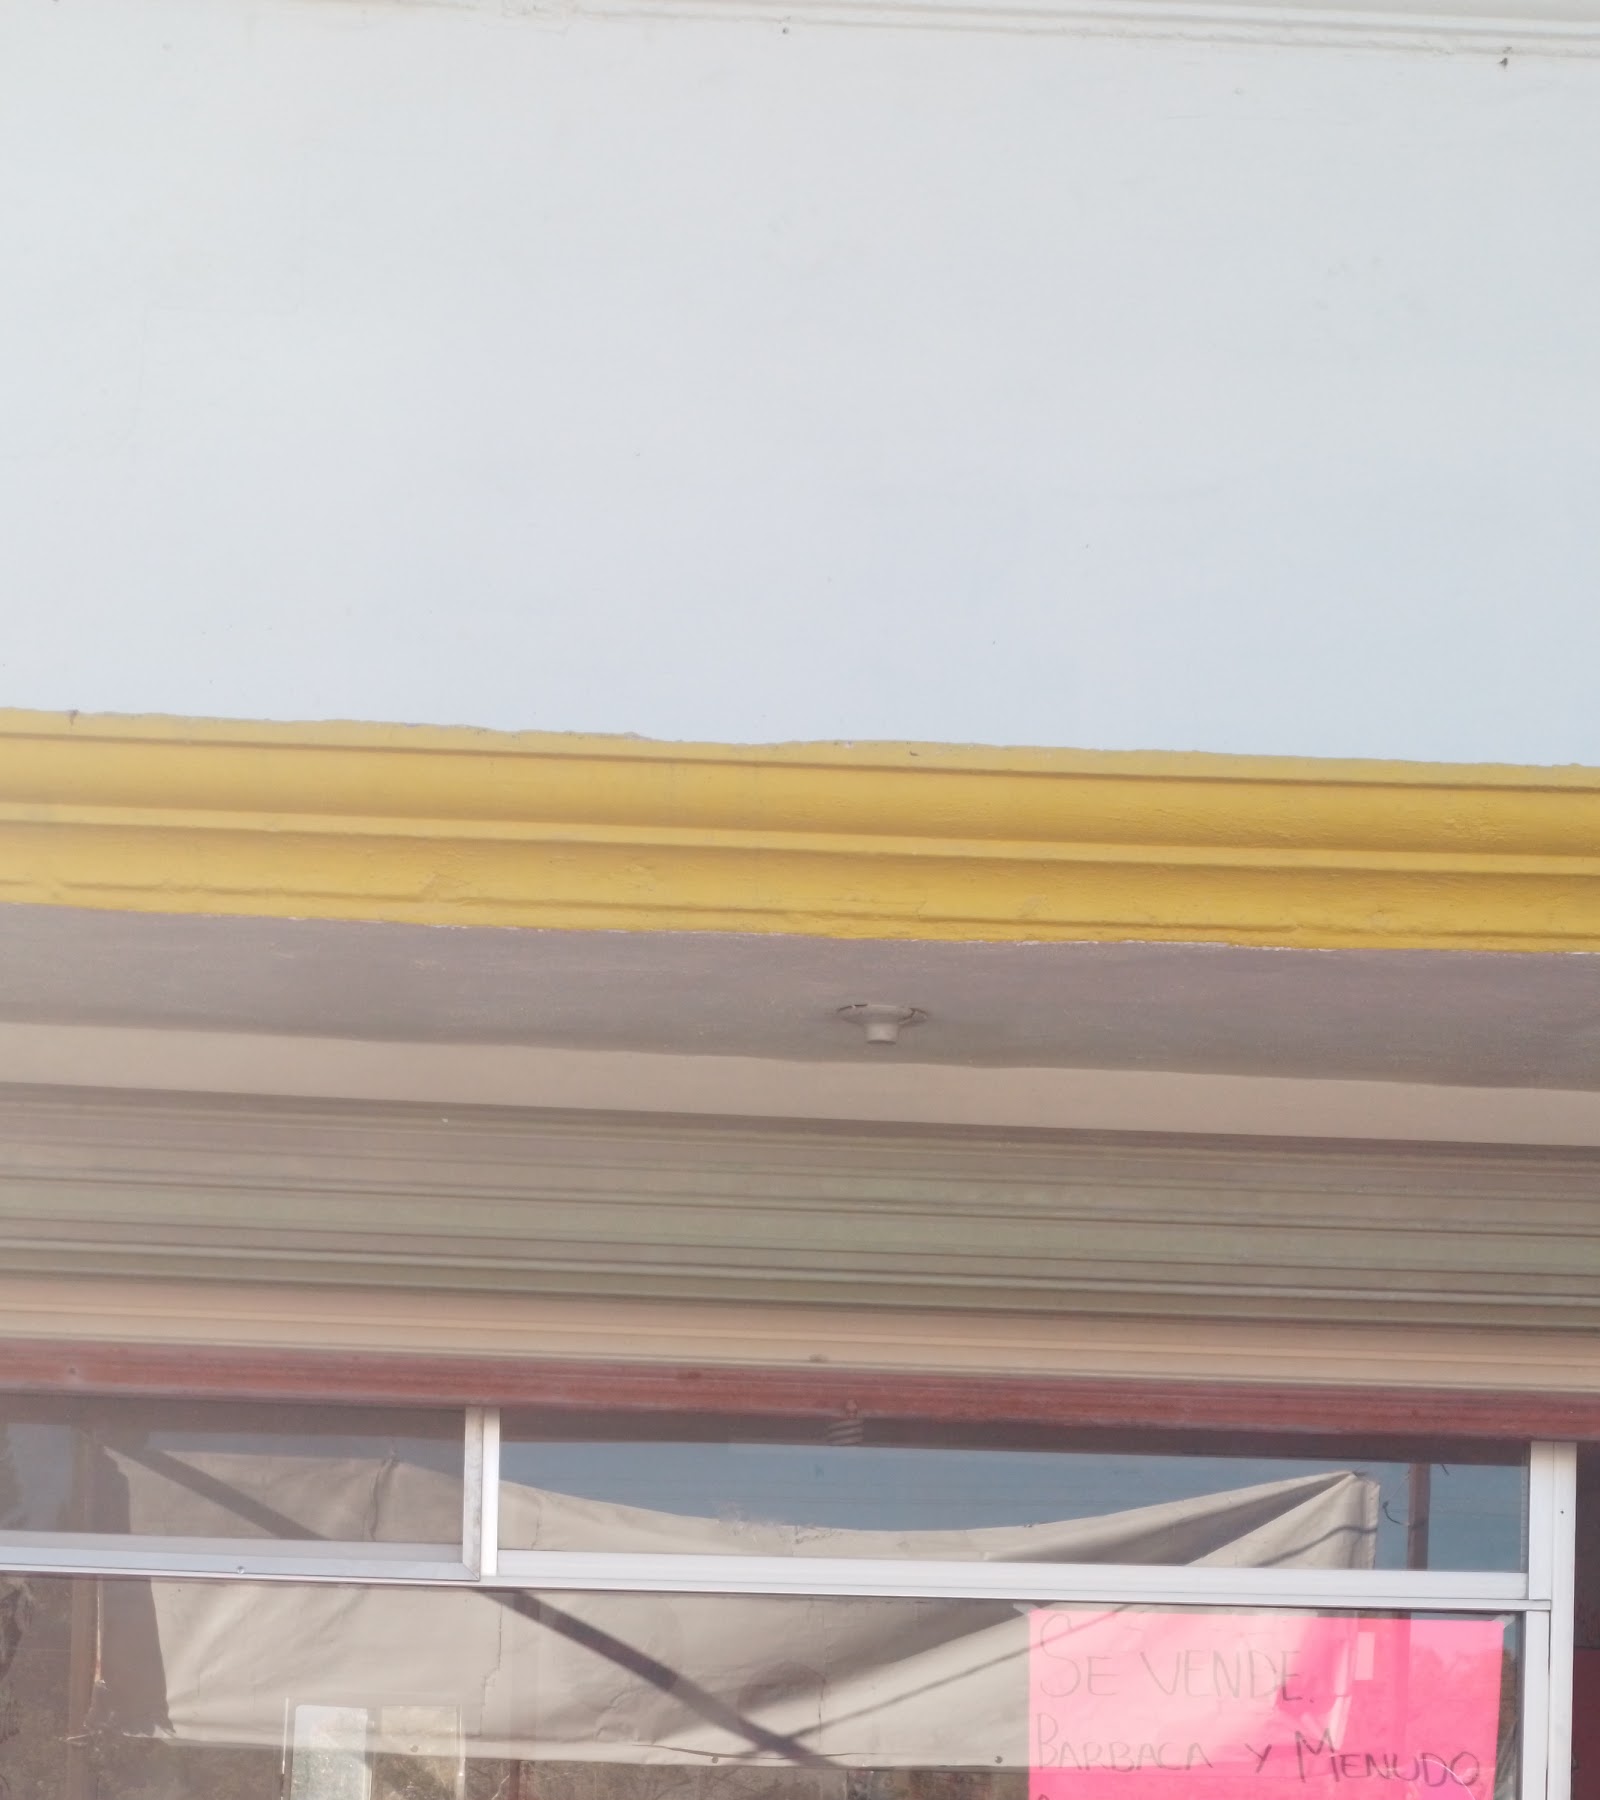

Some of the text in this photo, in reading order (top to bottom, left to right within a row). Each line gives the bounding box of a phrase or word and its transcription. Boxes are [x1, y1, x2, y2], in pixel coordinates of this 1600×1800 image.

[1039, 1613, 1120, 1698] SE
[1037, 1713, 1213, 1774] BARBACA
[1294, 1727, 1481, 1789] MENUDO
